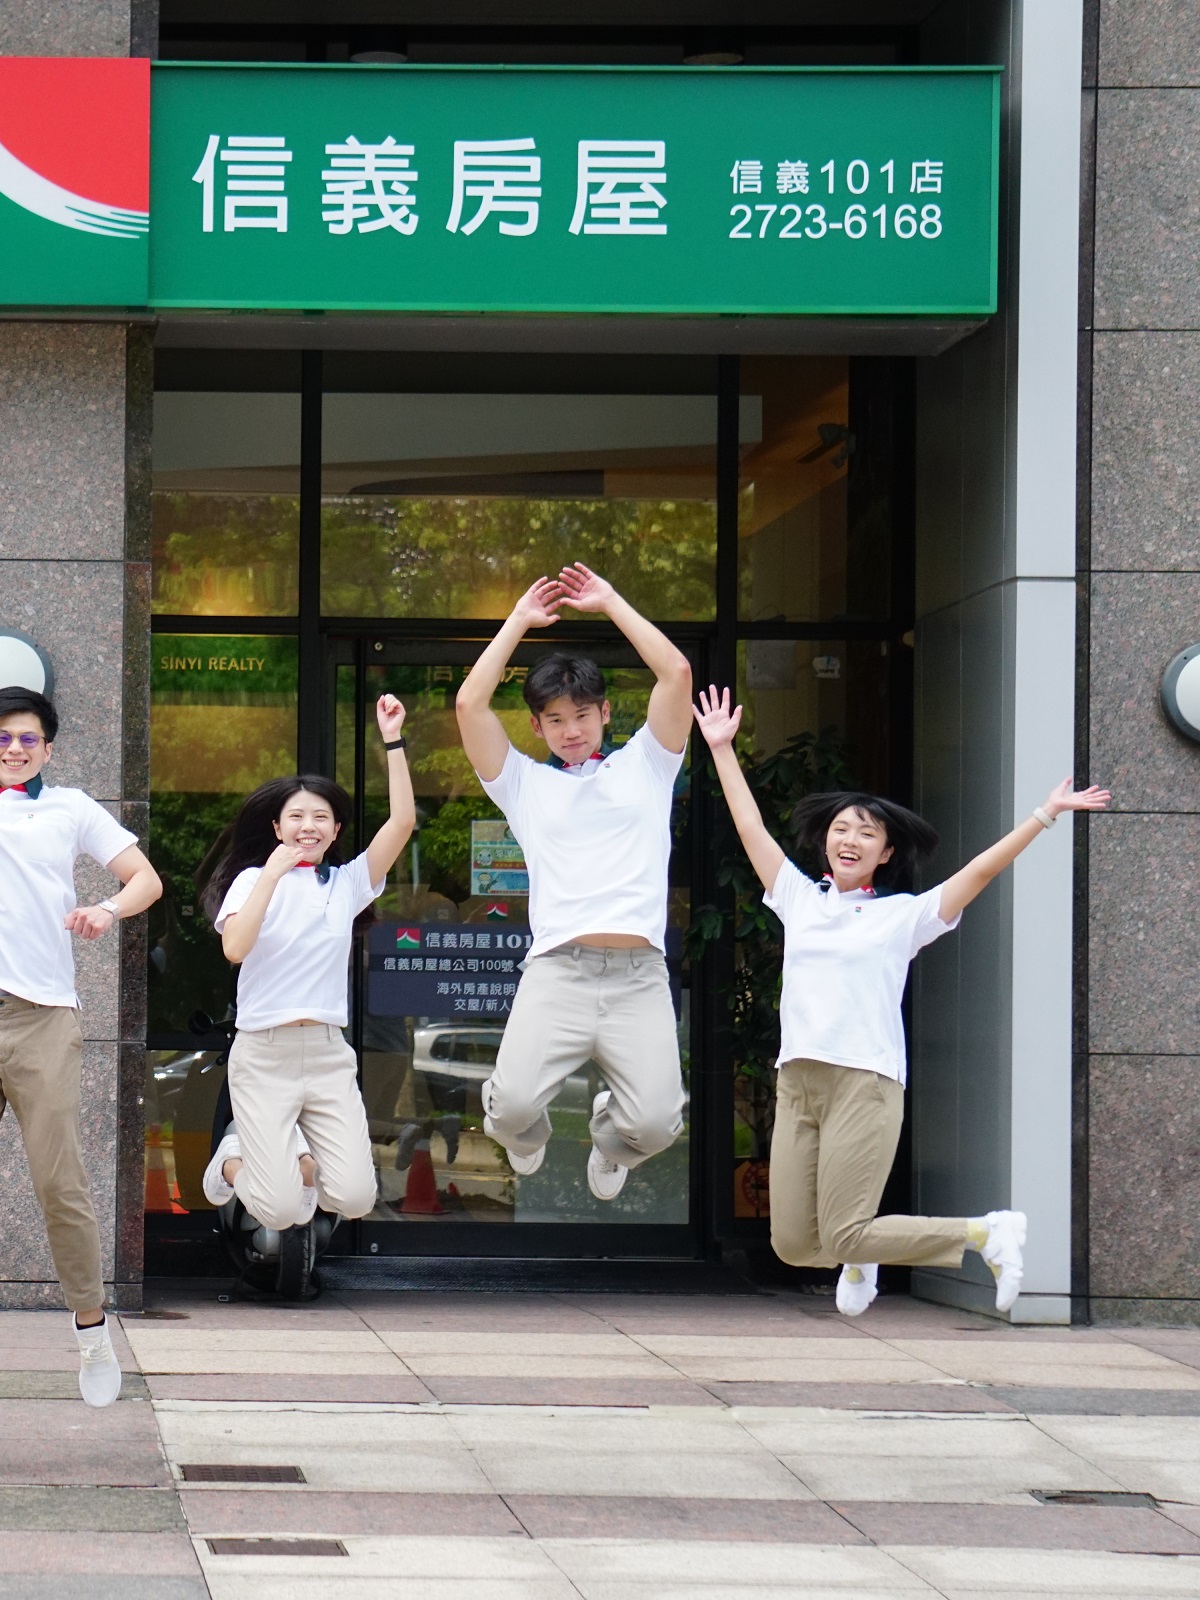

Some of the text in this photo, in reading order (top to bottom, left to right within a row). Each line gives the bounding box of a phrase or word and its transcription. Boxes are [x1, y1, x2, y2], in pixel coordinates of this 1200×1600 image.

[191, 134, 668, 237] 信義房屋
[728, 203, 943, 240] 2723-6168
[160, 656, 265, 671] SINYI REALTY
[436, 982, 519, 996] 海外房產說明
